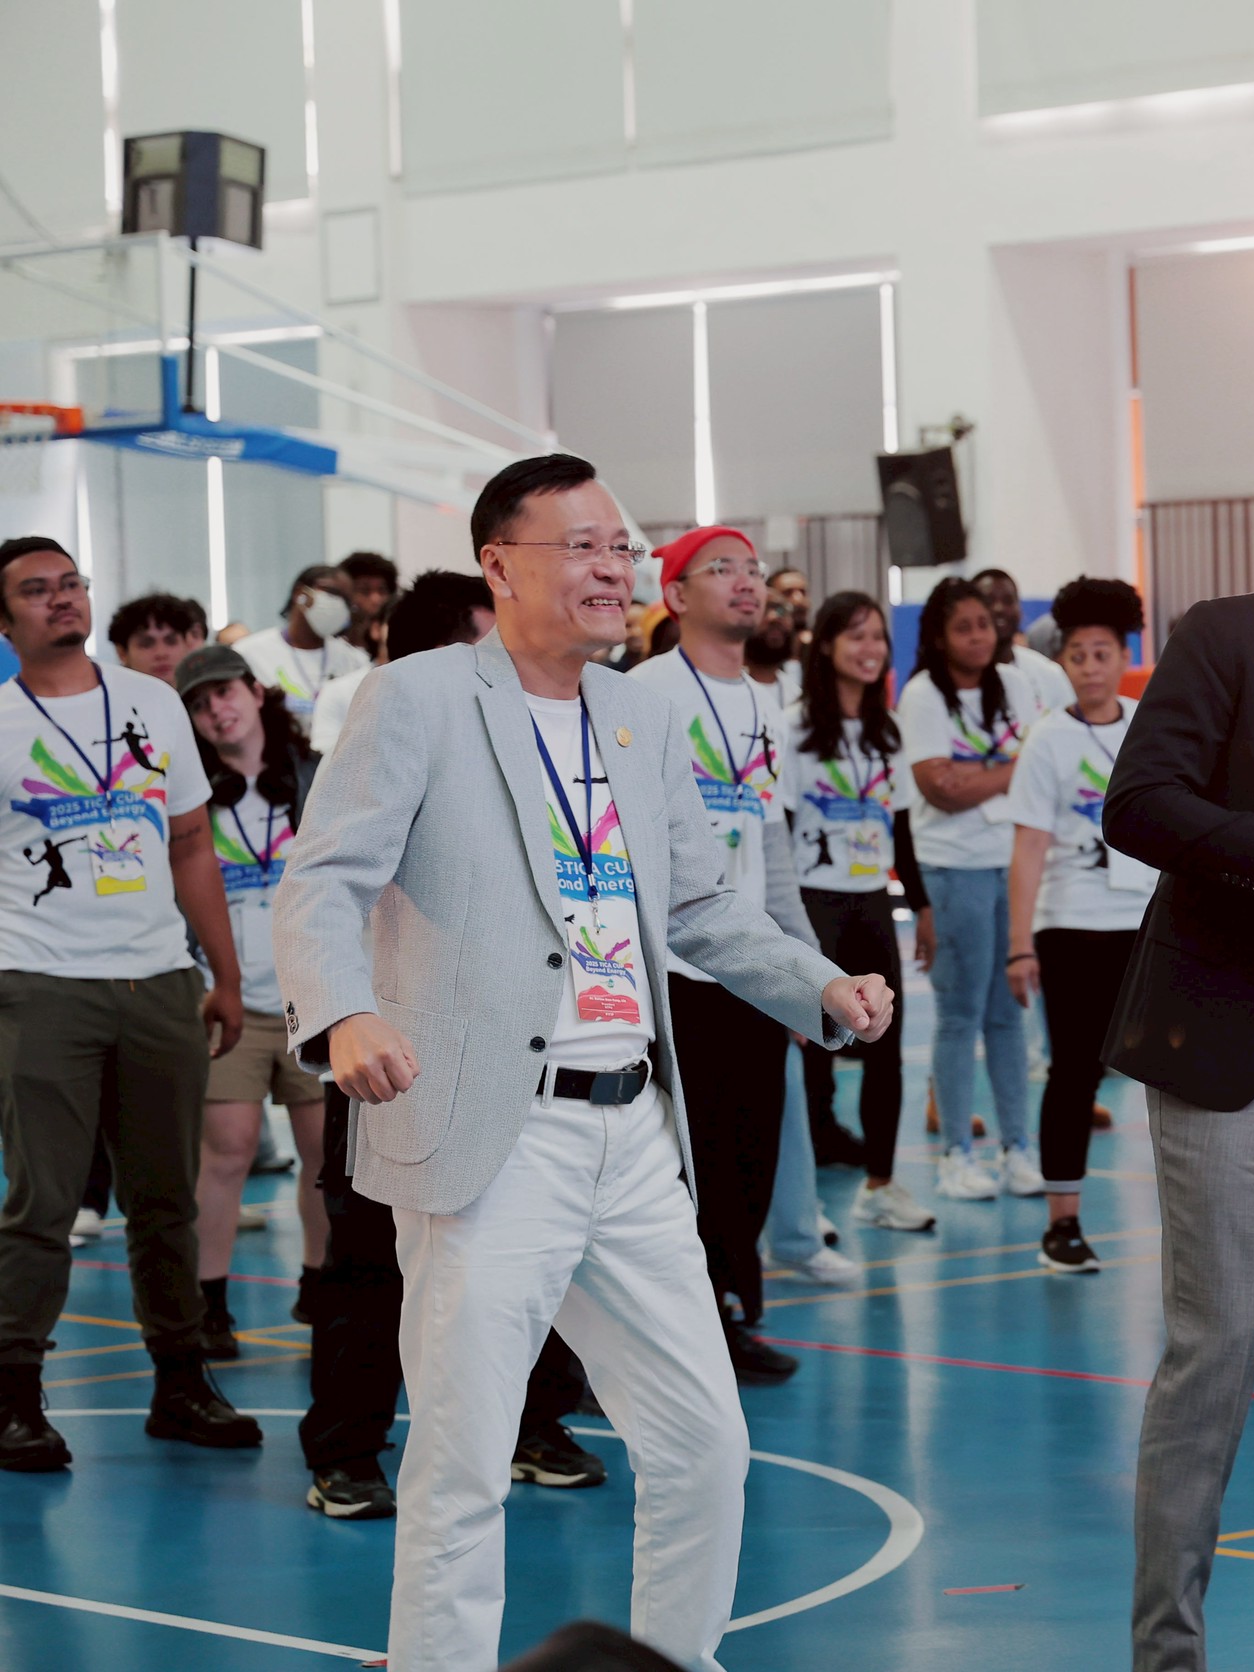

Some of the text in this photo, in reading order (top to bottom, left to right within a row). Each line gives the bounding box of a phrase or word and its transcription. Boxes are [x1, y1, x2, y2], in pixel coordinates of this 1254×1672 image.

[49, 801, 80, 816] 2025
[84, 796, 108, 809] TIC
[50, 808, 99, 828] Beyond
[604, 860, 632, 876] CU
[558, 877, 635, 893] ond nerg
[586, 966, 606, 974] Beyond
